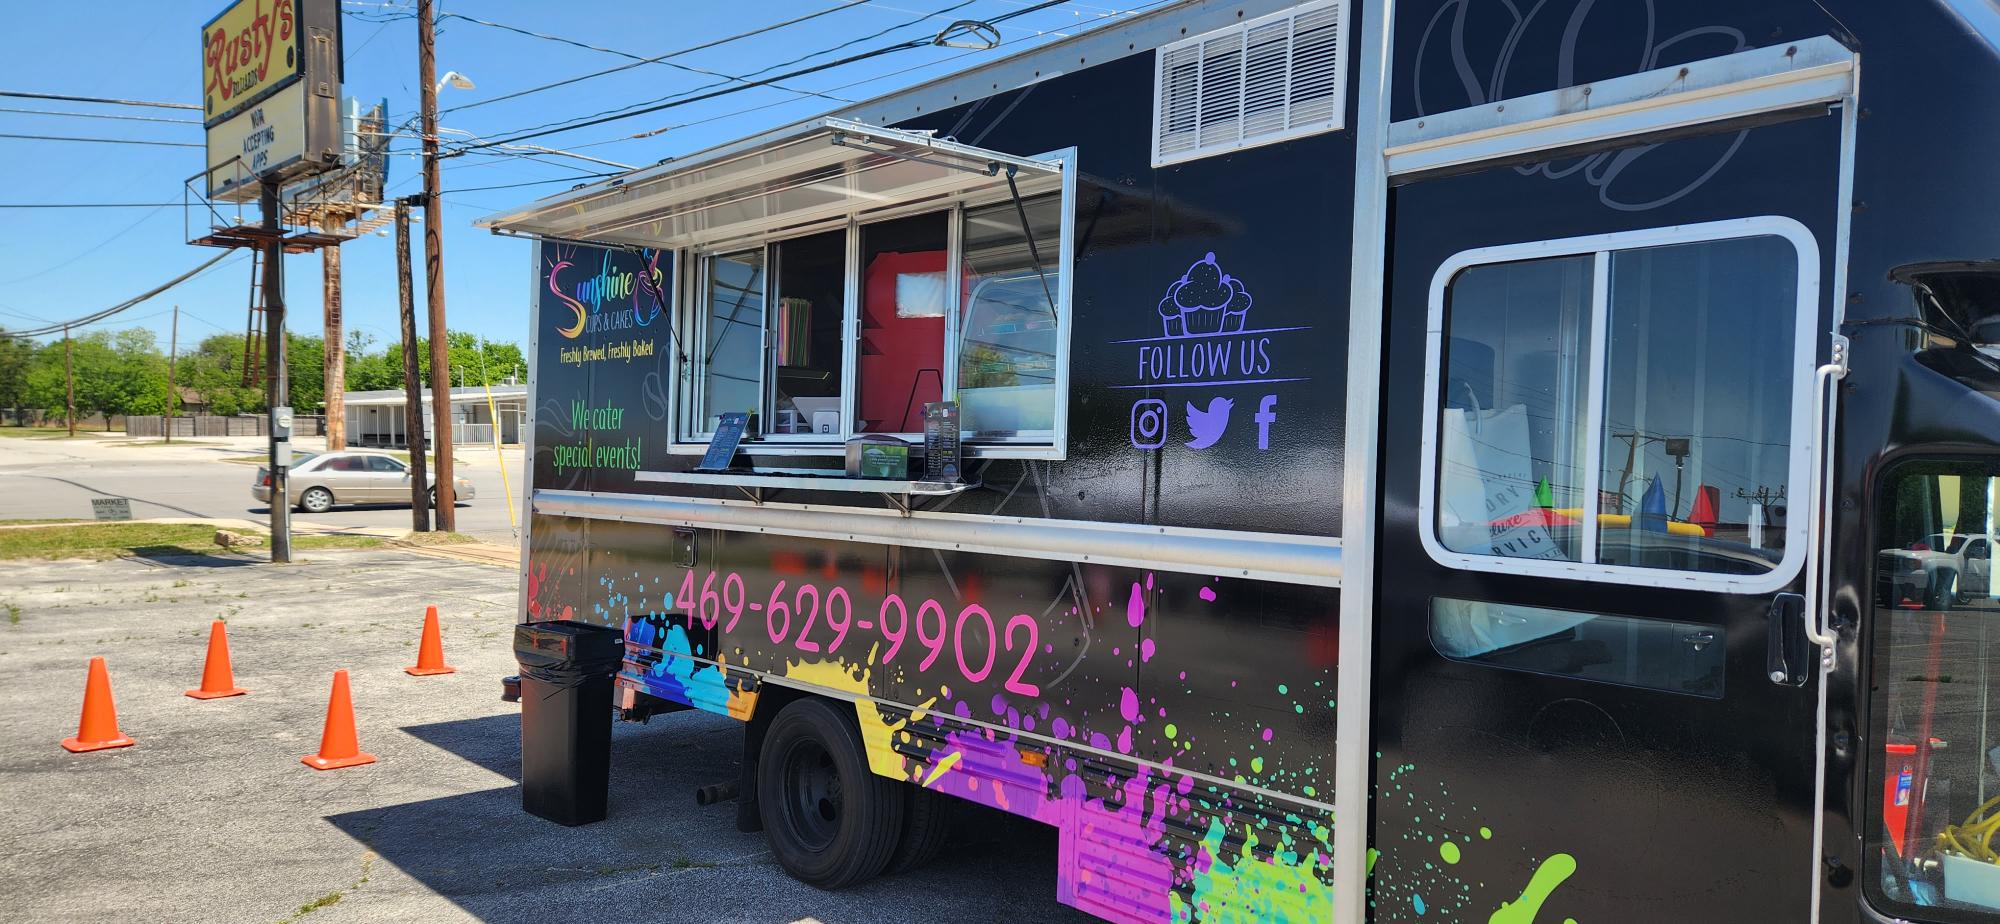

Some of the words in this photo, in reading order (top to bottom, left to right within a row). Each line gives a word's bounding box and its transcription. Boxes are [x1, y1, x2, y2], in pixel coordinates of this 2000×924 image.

[243, 126, 274, 154] ACCEPTING
[252, 150, 268, 170] APPS
[549, 248, 637, 339] Sunshine
[585, 313, 602, 333] CUPS
[603, 312, 609, 331] &
[611, 309, 633, 330] CAKES
[560, 347, 581, 367] Freshly
[608, 341, 631, 364] Freshly
[633, 338, 654, 357] Baked
[1139, 340, 1232, 380] FOLLOW
[1240, 337, 1271, 375] US
[571, 399, 590, 431] We
[592, 397, 625, 430] cater
[553, 436, 592, 476] special
[596, 436, 641, 470] events!
[91, 498, 129, 506] MARKET
[1490, 514, 1521, 537] luxe
[676, 569, 1040, 698] 469-629-9902
